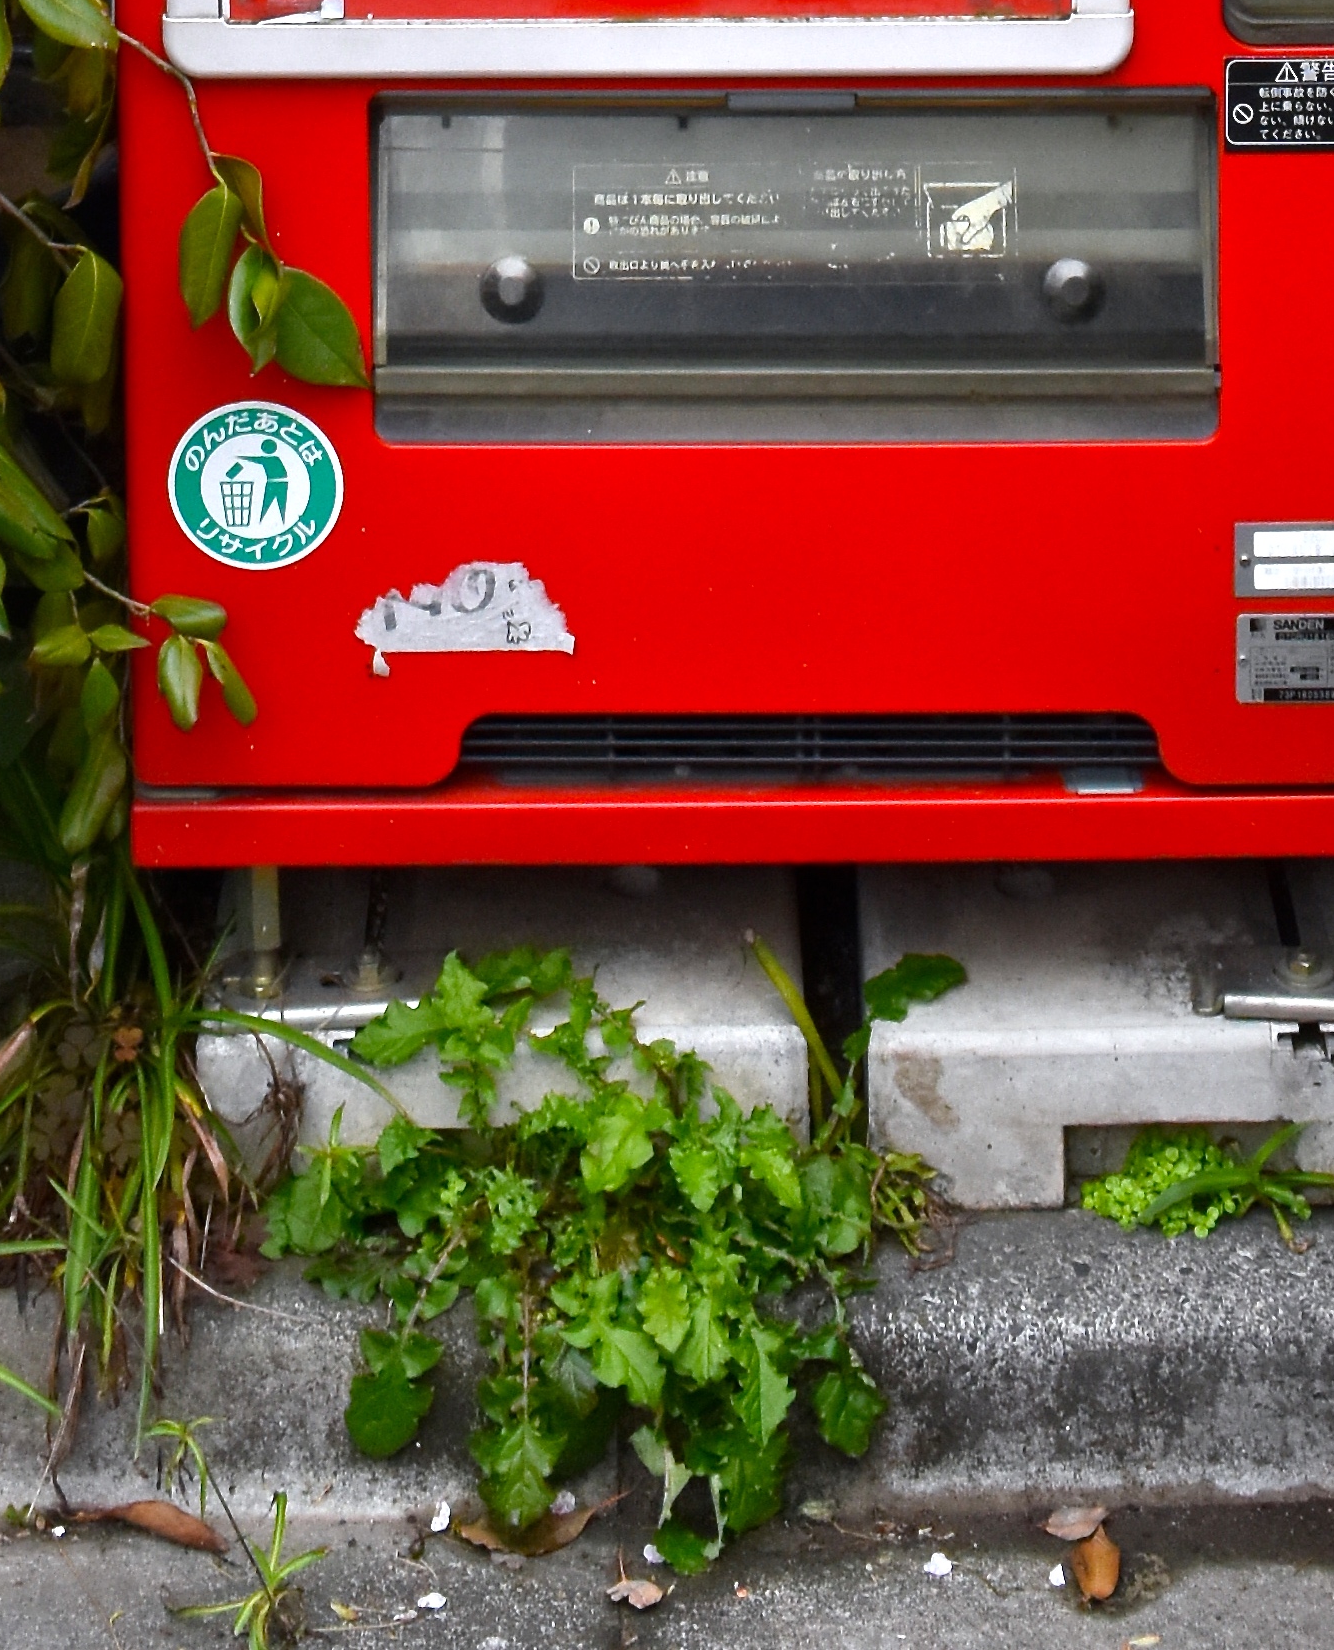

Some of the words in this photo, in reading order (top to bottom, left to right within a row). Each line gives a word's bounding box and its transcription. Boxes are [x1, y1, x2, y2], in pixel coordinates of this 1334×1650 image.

[1259, 128, 1322, 141] てください。
[184, 410, 323, 473] のんだあとは
[196, 514, 319, 562] リサイクル
[1273, 618, 1325, 631] SANDEN
